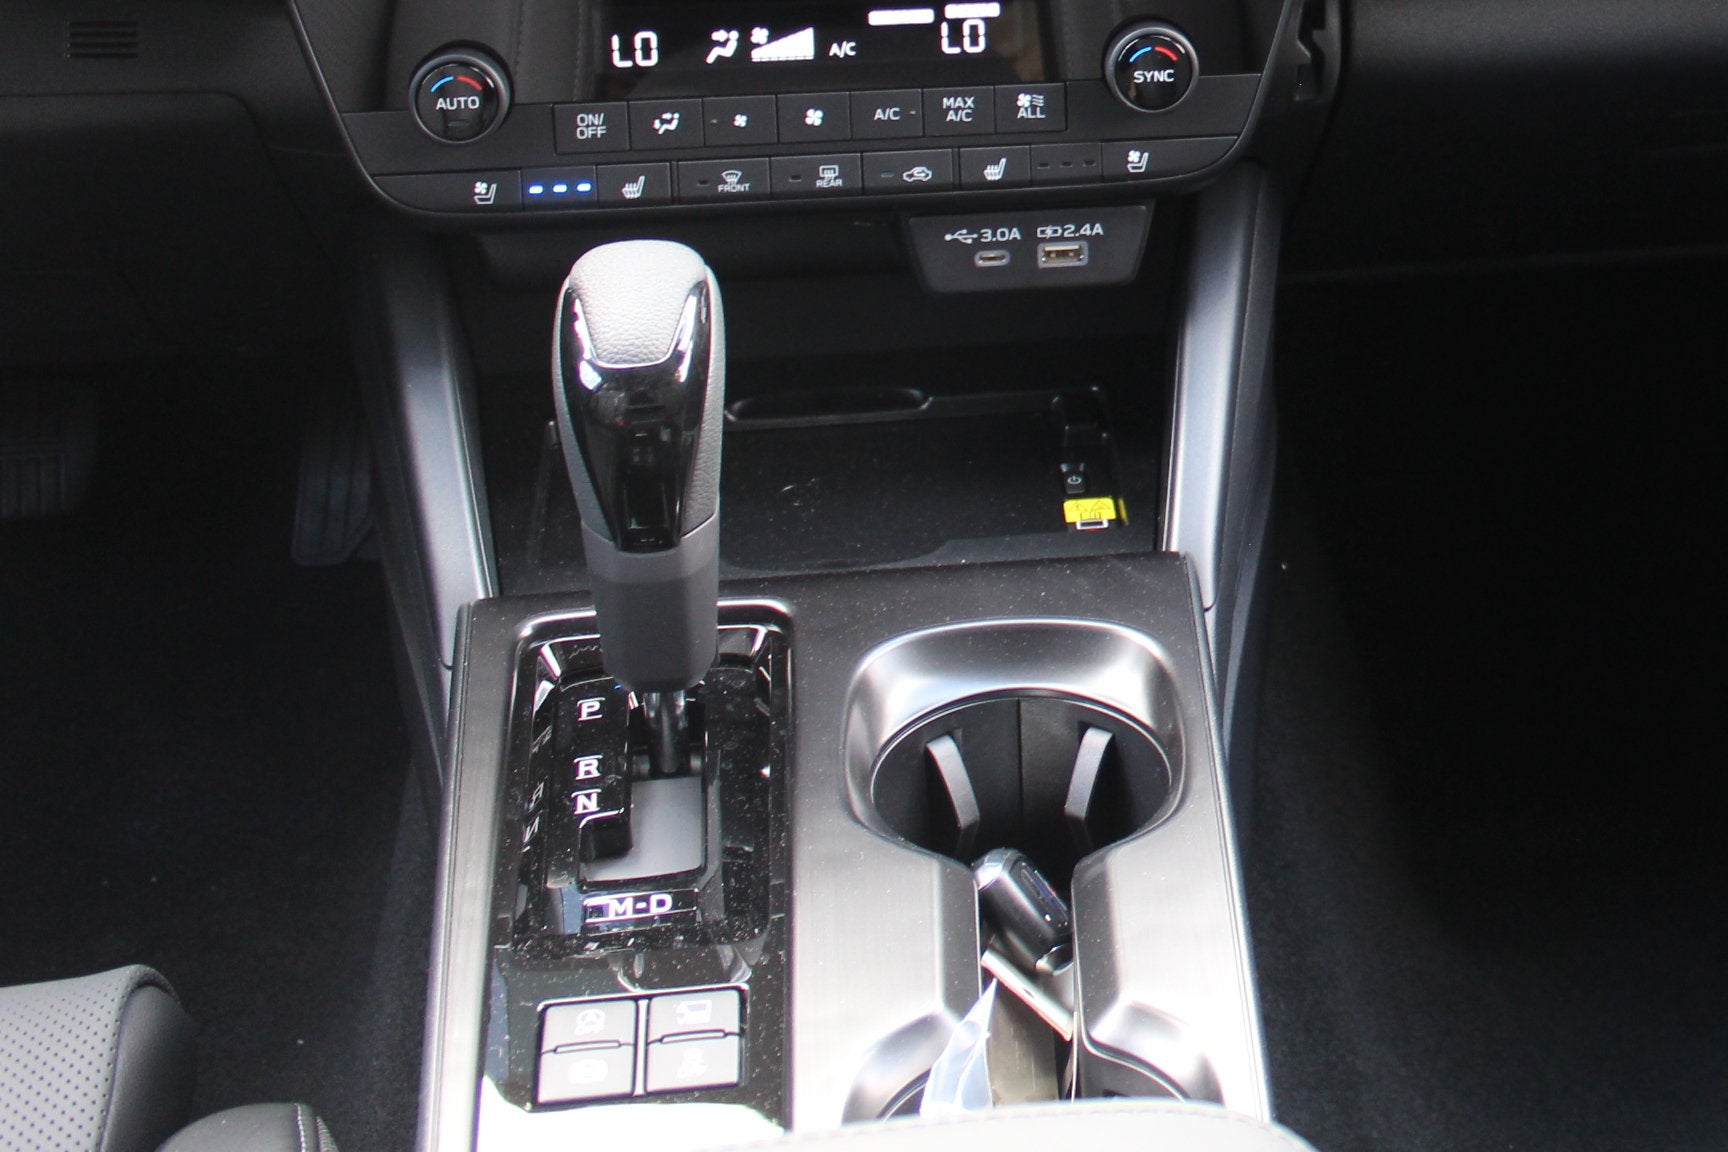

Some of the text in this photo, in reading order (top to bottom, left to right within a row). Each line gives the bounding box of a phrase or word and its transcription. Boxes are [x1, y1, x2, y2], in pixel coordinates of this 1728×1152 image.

[828, 41, 857, 58] A/C
[1133, 70, 1174, 84] SYNC
[435, 95, 480, 111] AUTO
[942, 96, 975, 110] MAX
[874, 108, 900, 122] A/C
[946, 110, 973, 123] A/C
[1017, 106, 1046, 120] ALL
[576, 113, 605, 128] ON/
[576, 126, 607, 140] OFF
[718, 182, 749, 192] FRONT
[816, 177, 842, 188] REAR
[980, 228, 1021, 242] 3.0A
[1063, 223, 1104, 237] 2.4A
[580, 701, 600, 716] P
[578, 759, 599, 777] R
[575, 793, 599, 811] N
[607, 893, 673, 916] M-D
